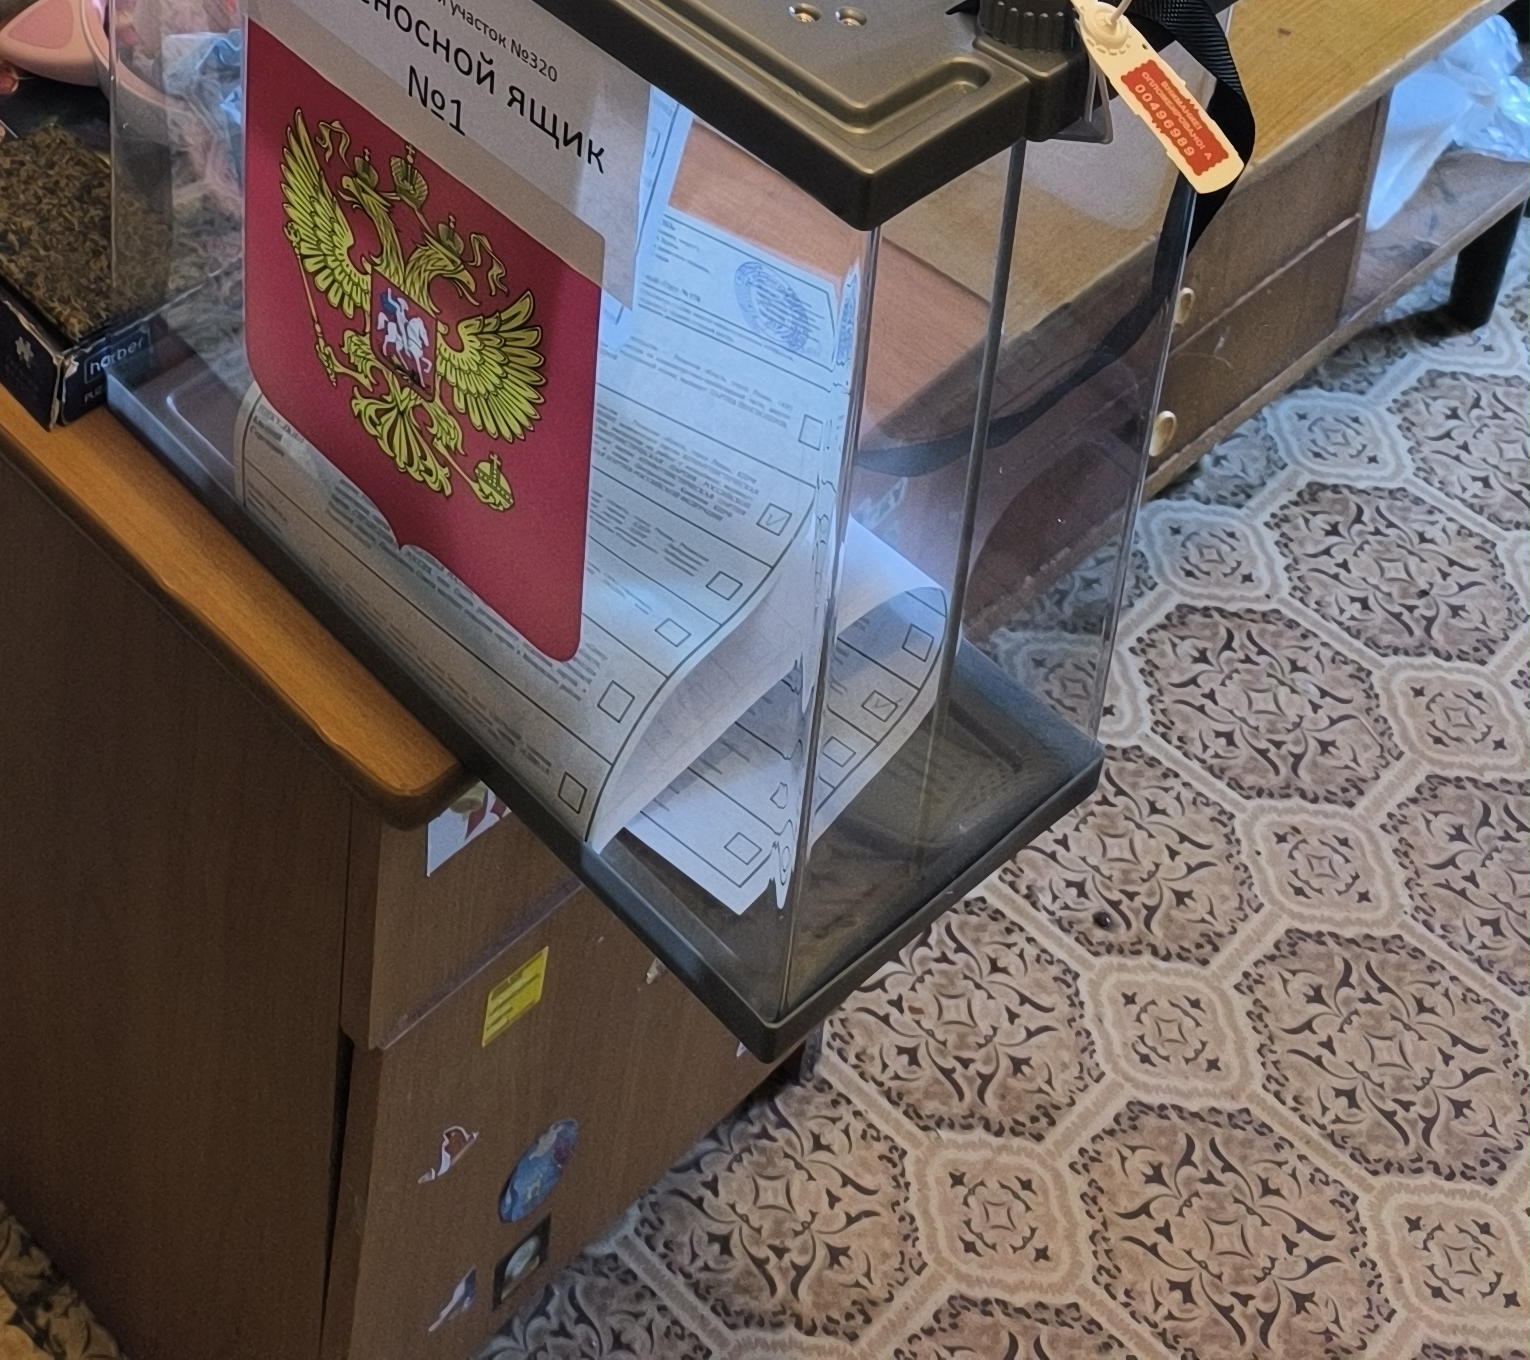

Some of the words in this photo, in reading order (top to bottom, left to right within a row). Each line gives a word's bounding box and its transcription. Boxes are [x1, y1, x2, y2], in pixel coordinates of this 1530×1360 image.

[510, 38, 558, 82] №320
[408, 65, 466, 136] №1
[506, 86, 605, 174] ящик
[1135, 84, 1195, 156] 00496989
[1161, 81, 1202, 130] ВНИМАНИЕ!
